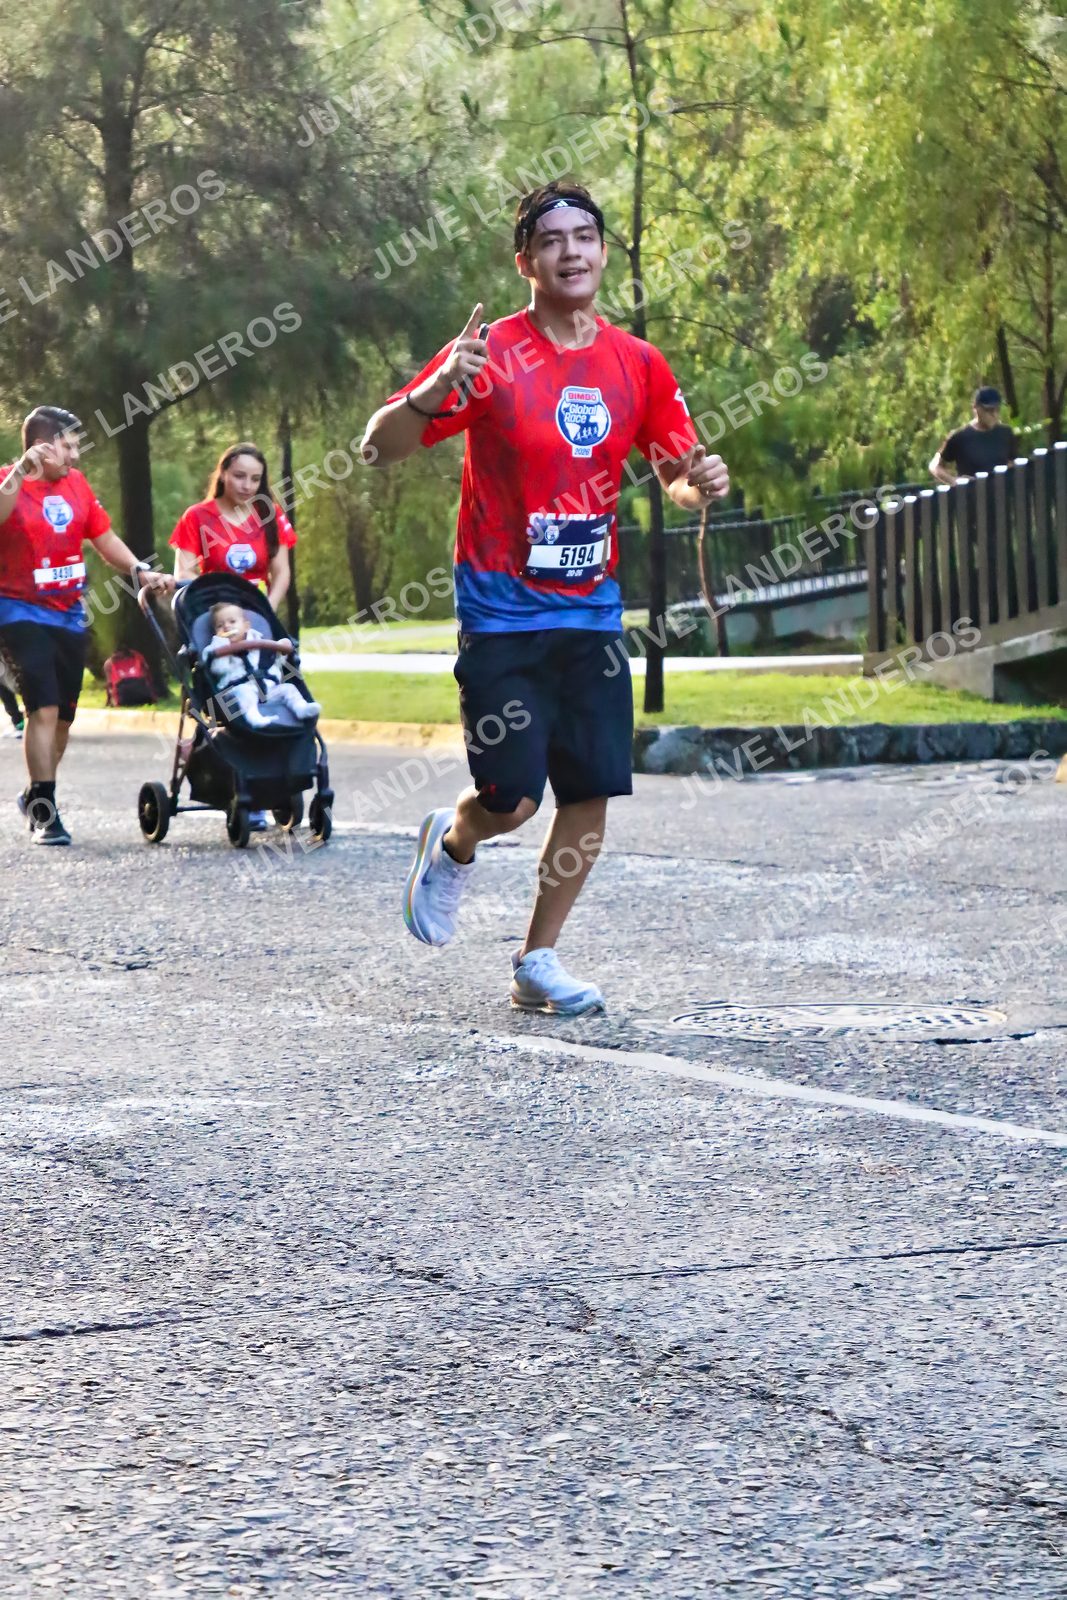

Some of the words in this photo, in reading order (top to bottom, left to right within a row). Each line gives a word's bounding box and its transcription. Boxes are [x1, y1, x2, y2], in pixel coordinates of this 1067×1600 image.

[568, 392, 597, 401] BIMBO
[569, 403, 597, 415] Global
[564, 413, 587, 424] Race
[559, 545, 595, 567] 5194
[52, 566, 73, 580] 3430
